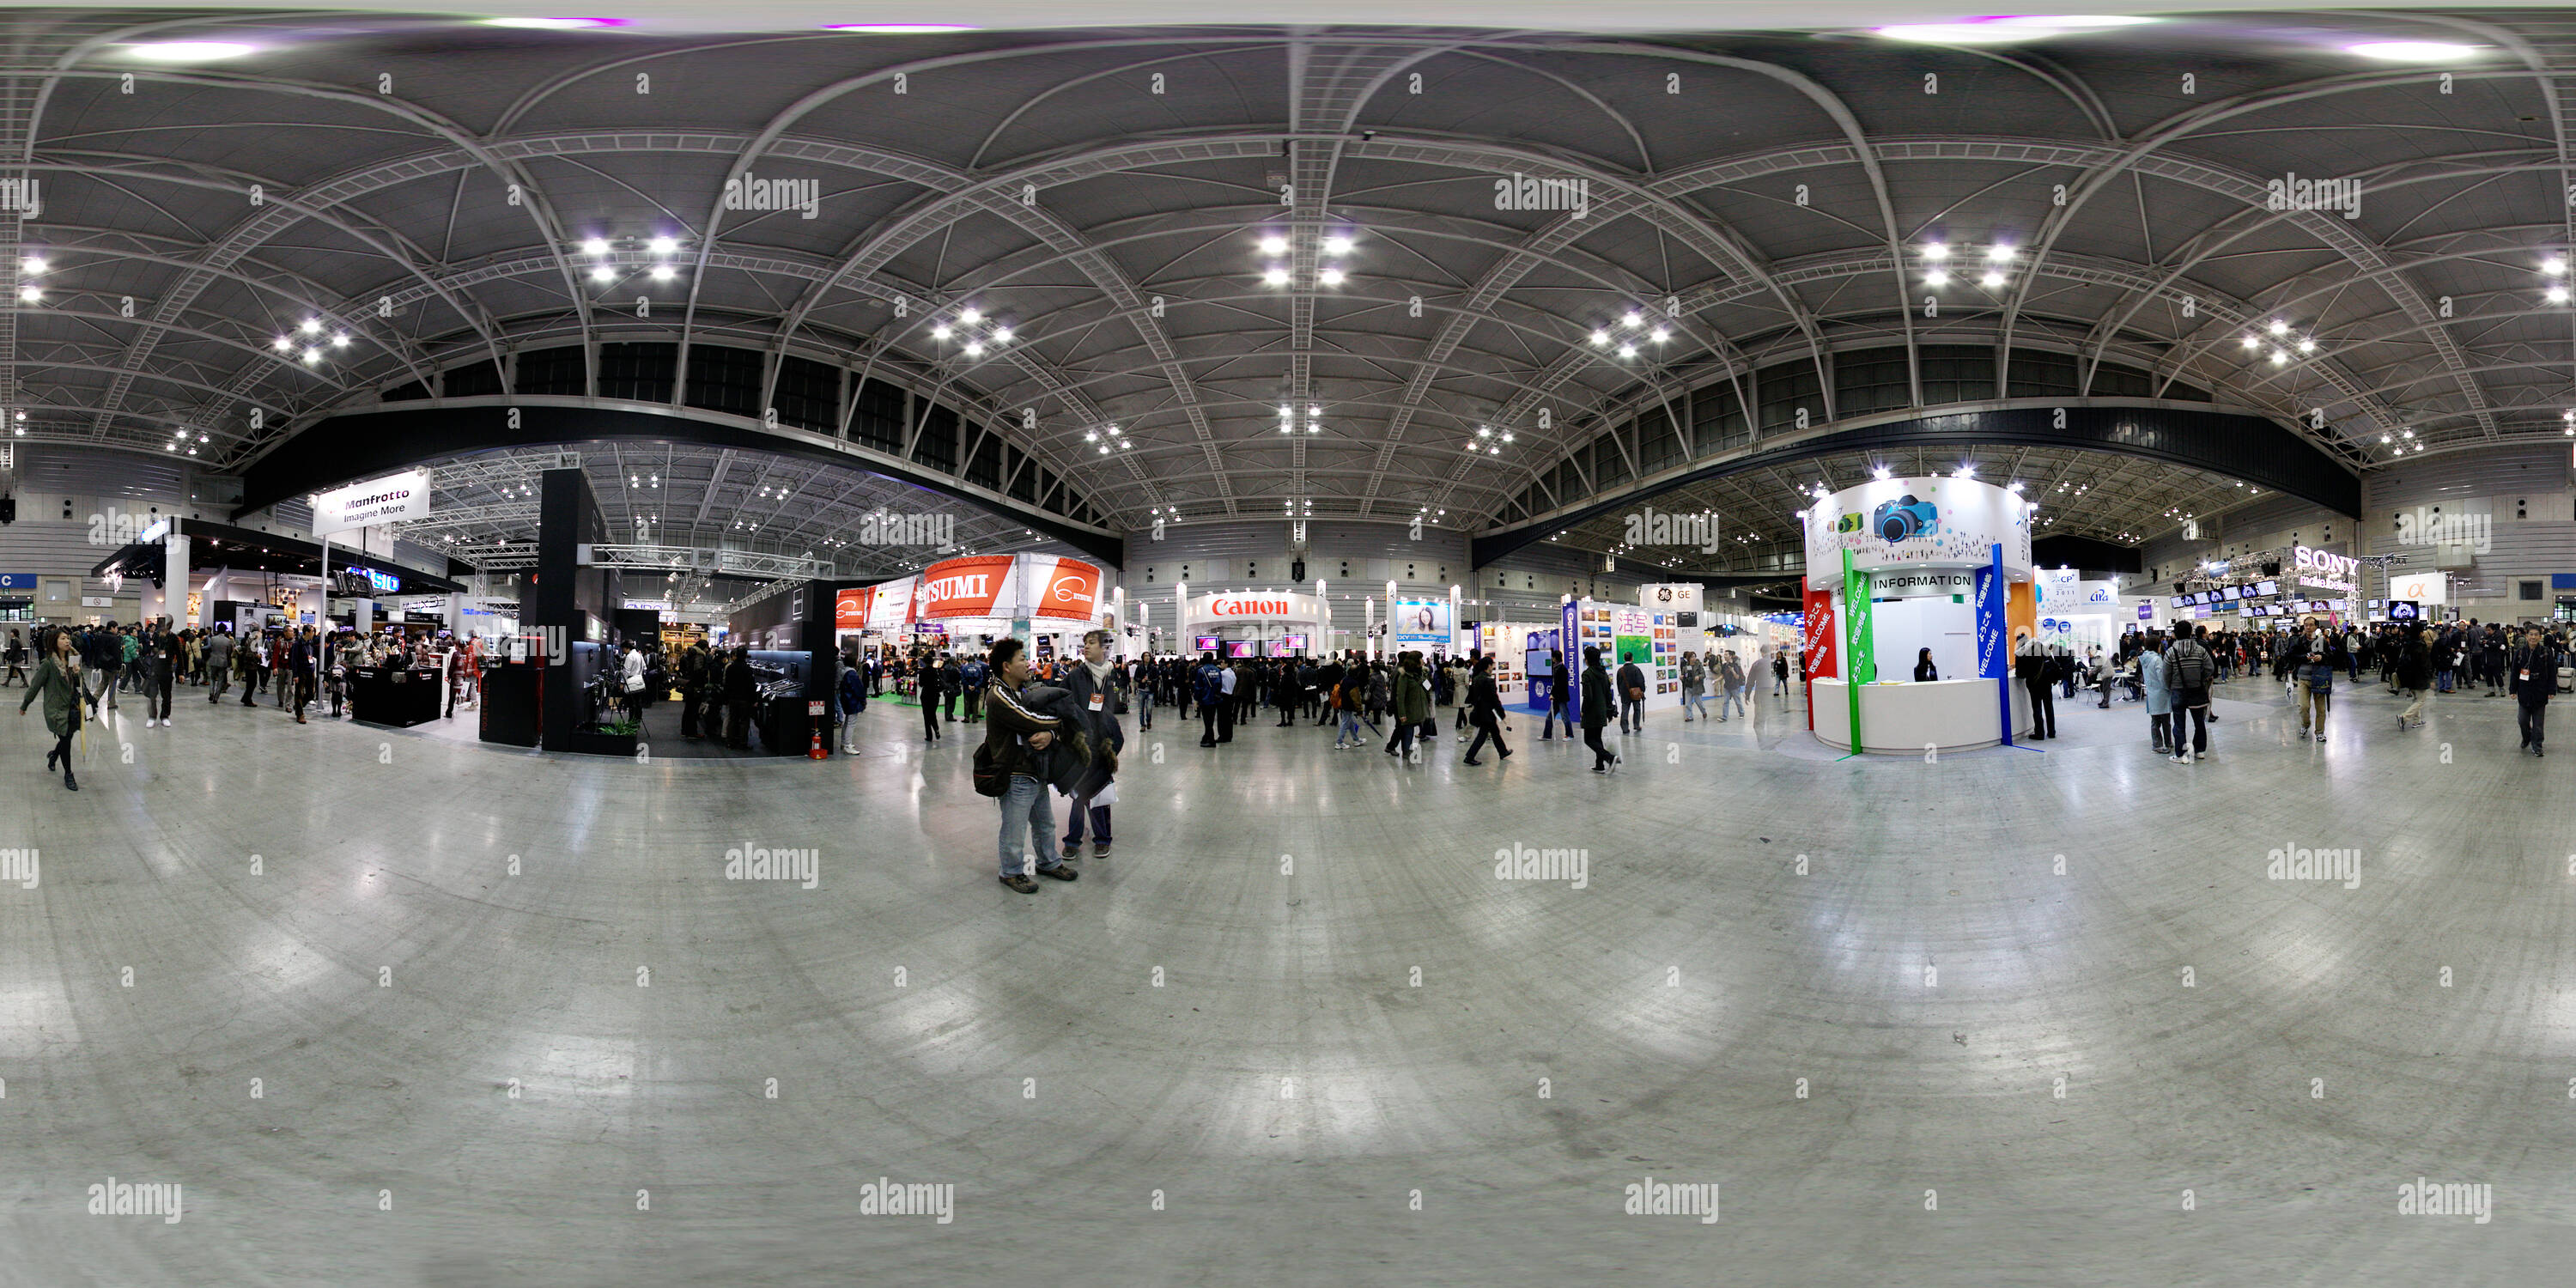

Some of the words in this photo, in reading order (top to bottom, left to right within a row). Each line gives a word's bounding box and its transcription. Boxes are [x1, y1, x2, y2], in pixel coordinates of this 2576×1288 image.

[345, 489, 410, 511] Manfrotto
[344, 510, 378, 523] Imagine
[380, 505, 405, 516] More
[2293, 545, 2360, 575] SONY
[1, 575, 12, 586] C
[1874, 575, 1971, 590] INFORMATION
[1678, 590, 1691, 599] GE
[1849, 572, 1868, 618] WELCOME
[1212, 598, 1288, 616] Canon
[1807, 602, 1823, 627] ようこそ
[1618, 612, 1648, 634] 活写
[1807, 613, 1831, 651] WELCOME
[1978, 611, 1992, 642] ようこそ
[1978, 629, 1999, 677] WELCOME
[1852, 650, 1866, 683] ようこそ
